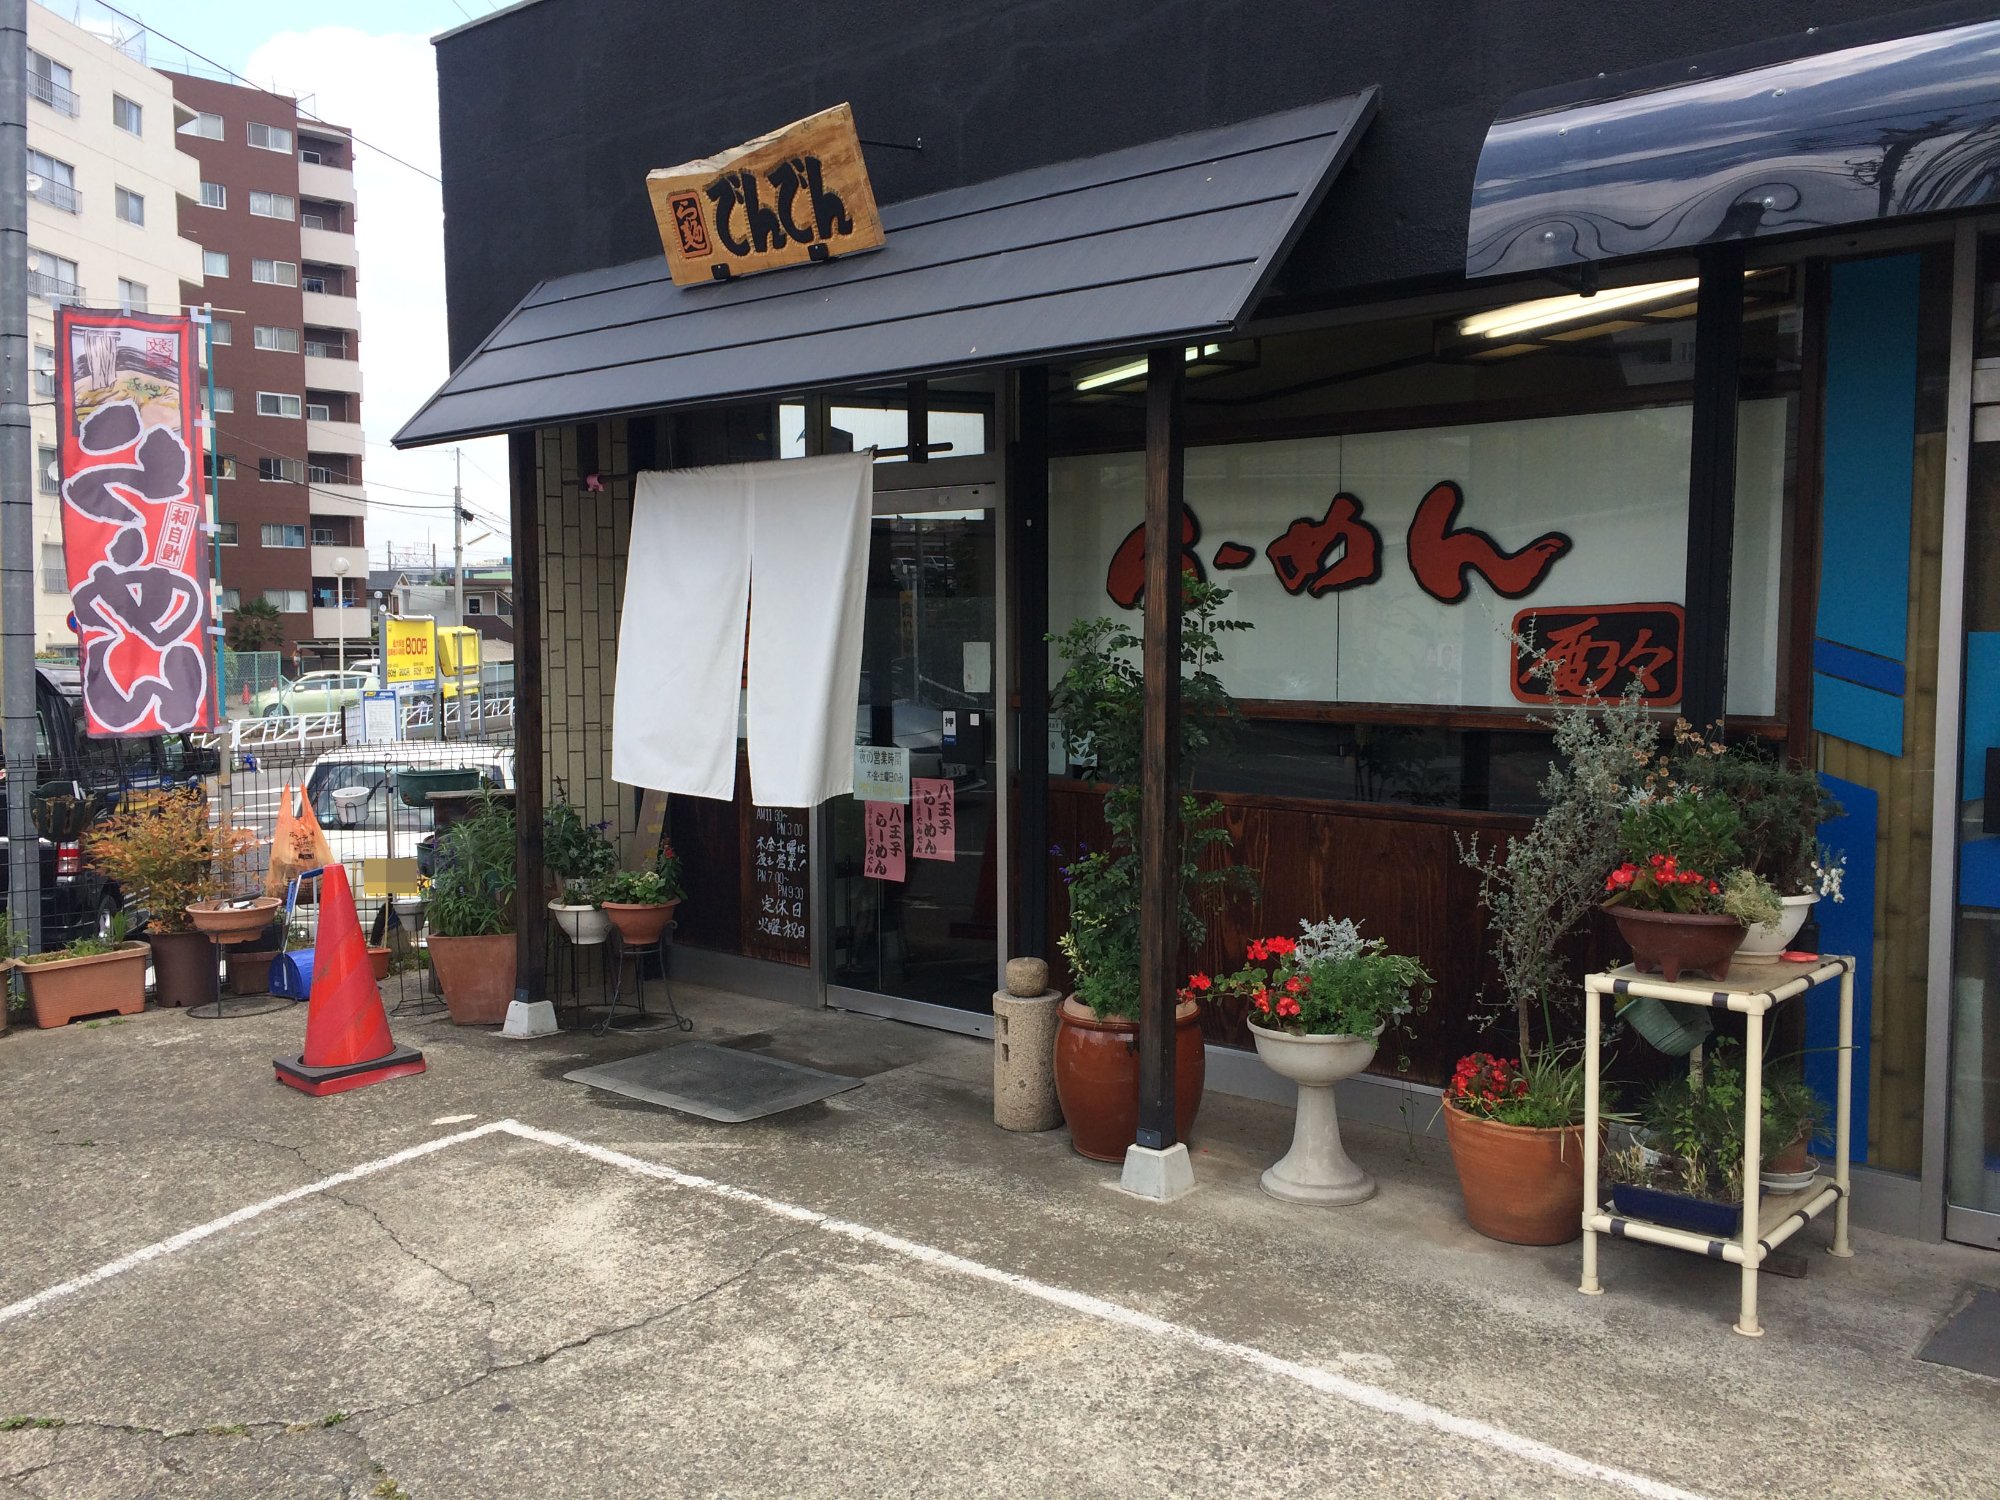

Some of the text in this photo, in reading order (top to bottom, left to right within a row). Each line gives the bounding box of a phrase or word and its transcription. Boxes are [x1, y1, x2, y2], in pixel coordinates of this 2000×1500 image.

[706, 156, 853, 256] でんでん
[944, 716, 954, 728] 押
[859, 749, 902, 767] 夜の営業時間
[889, 807, 903, 858] 八王子
[924, 790, 937, 855] らーめん
[938, 783, 953, 836] 八王子
[756, 836, 806, 853] 木金土曜は
[874, 812, 888, 875] らーめん
[761, 894, 802, 918] 定休日
